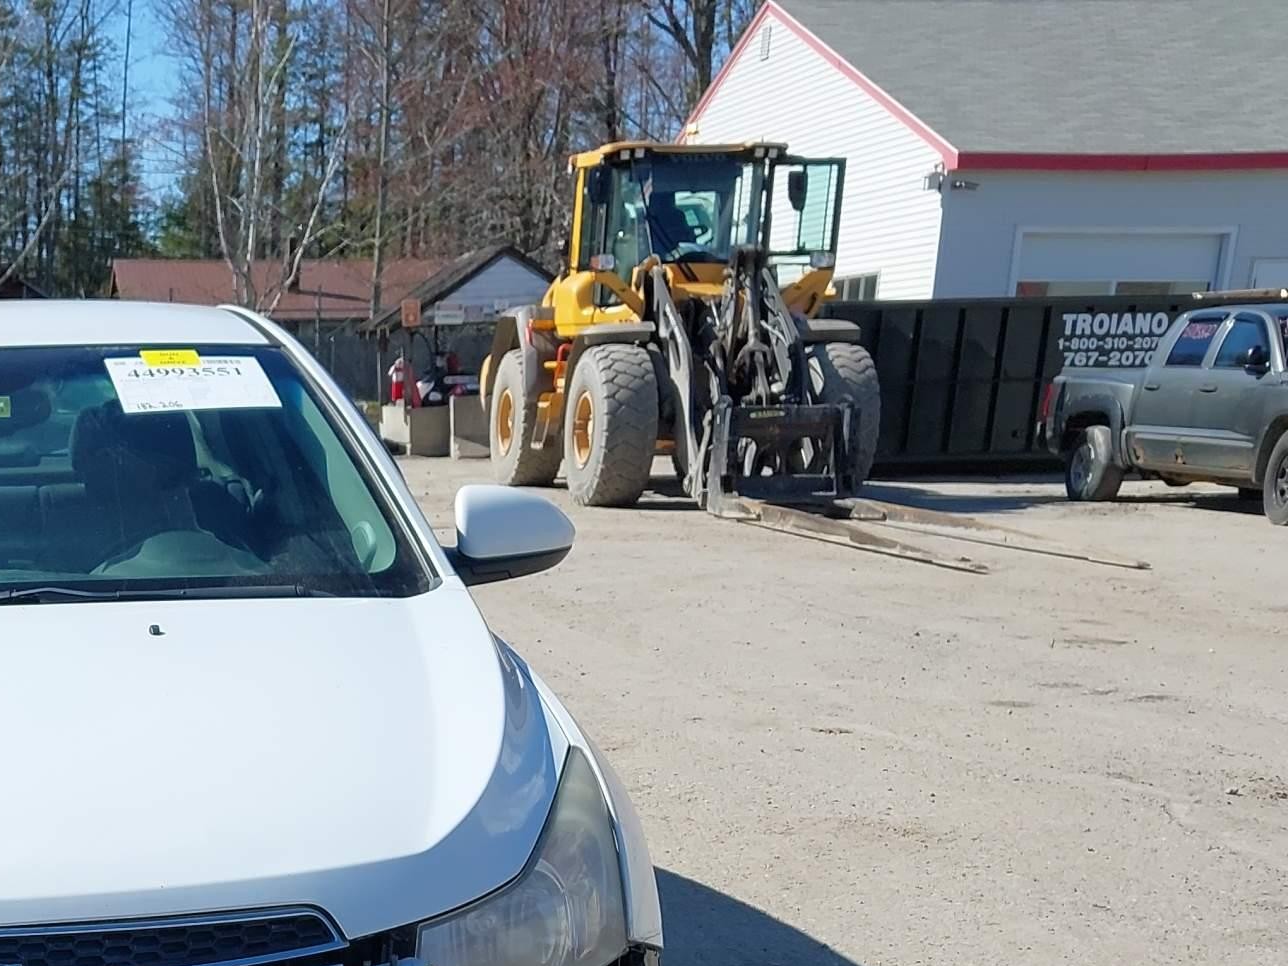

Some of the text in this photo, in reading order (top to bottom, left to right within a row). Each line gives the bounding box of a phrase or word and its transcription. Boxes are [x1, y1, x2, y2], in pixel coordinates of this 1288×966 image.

[1062, 312, 1169, 335] TROIANO
[1058, 336, 1161, 350] 1-800-310-207
[127, 366, 243, 379] 44993551
